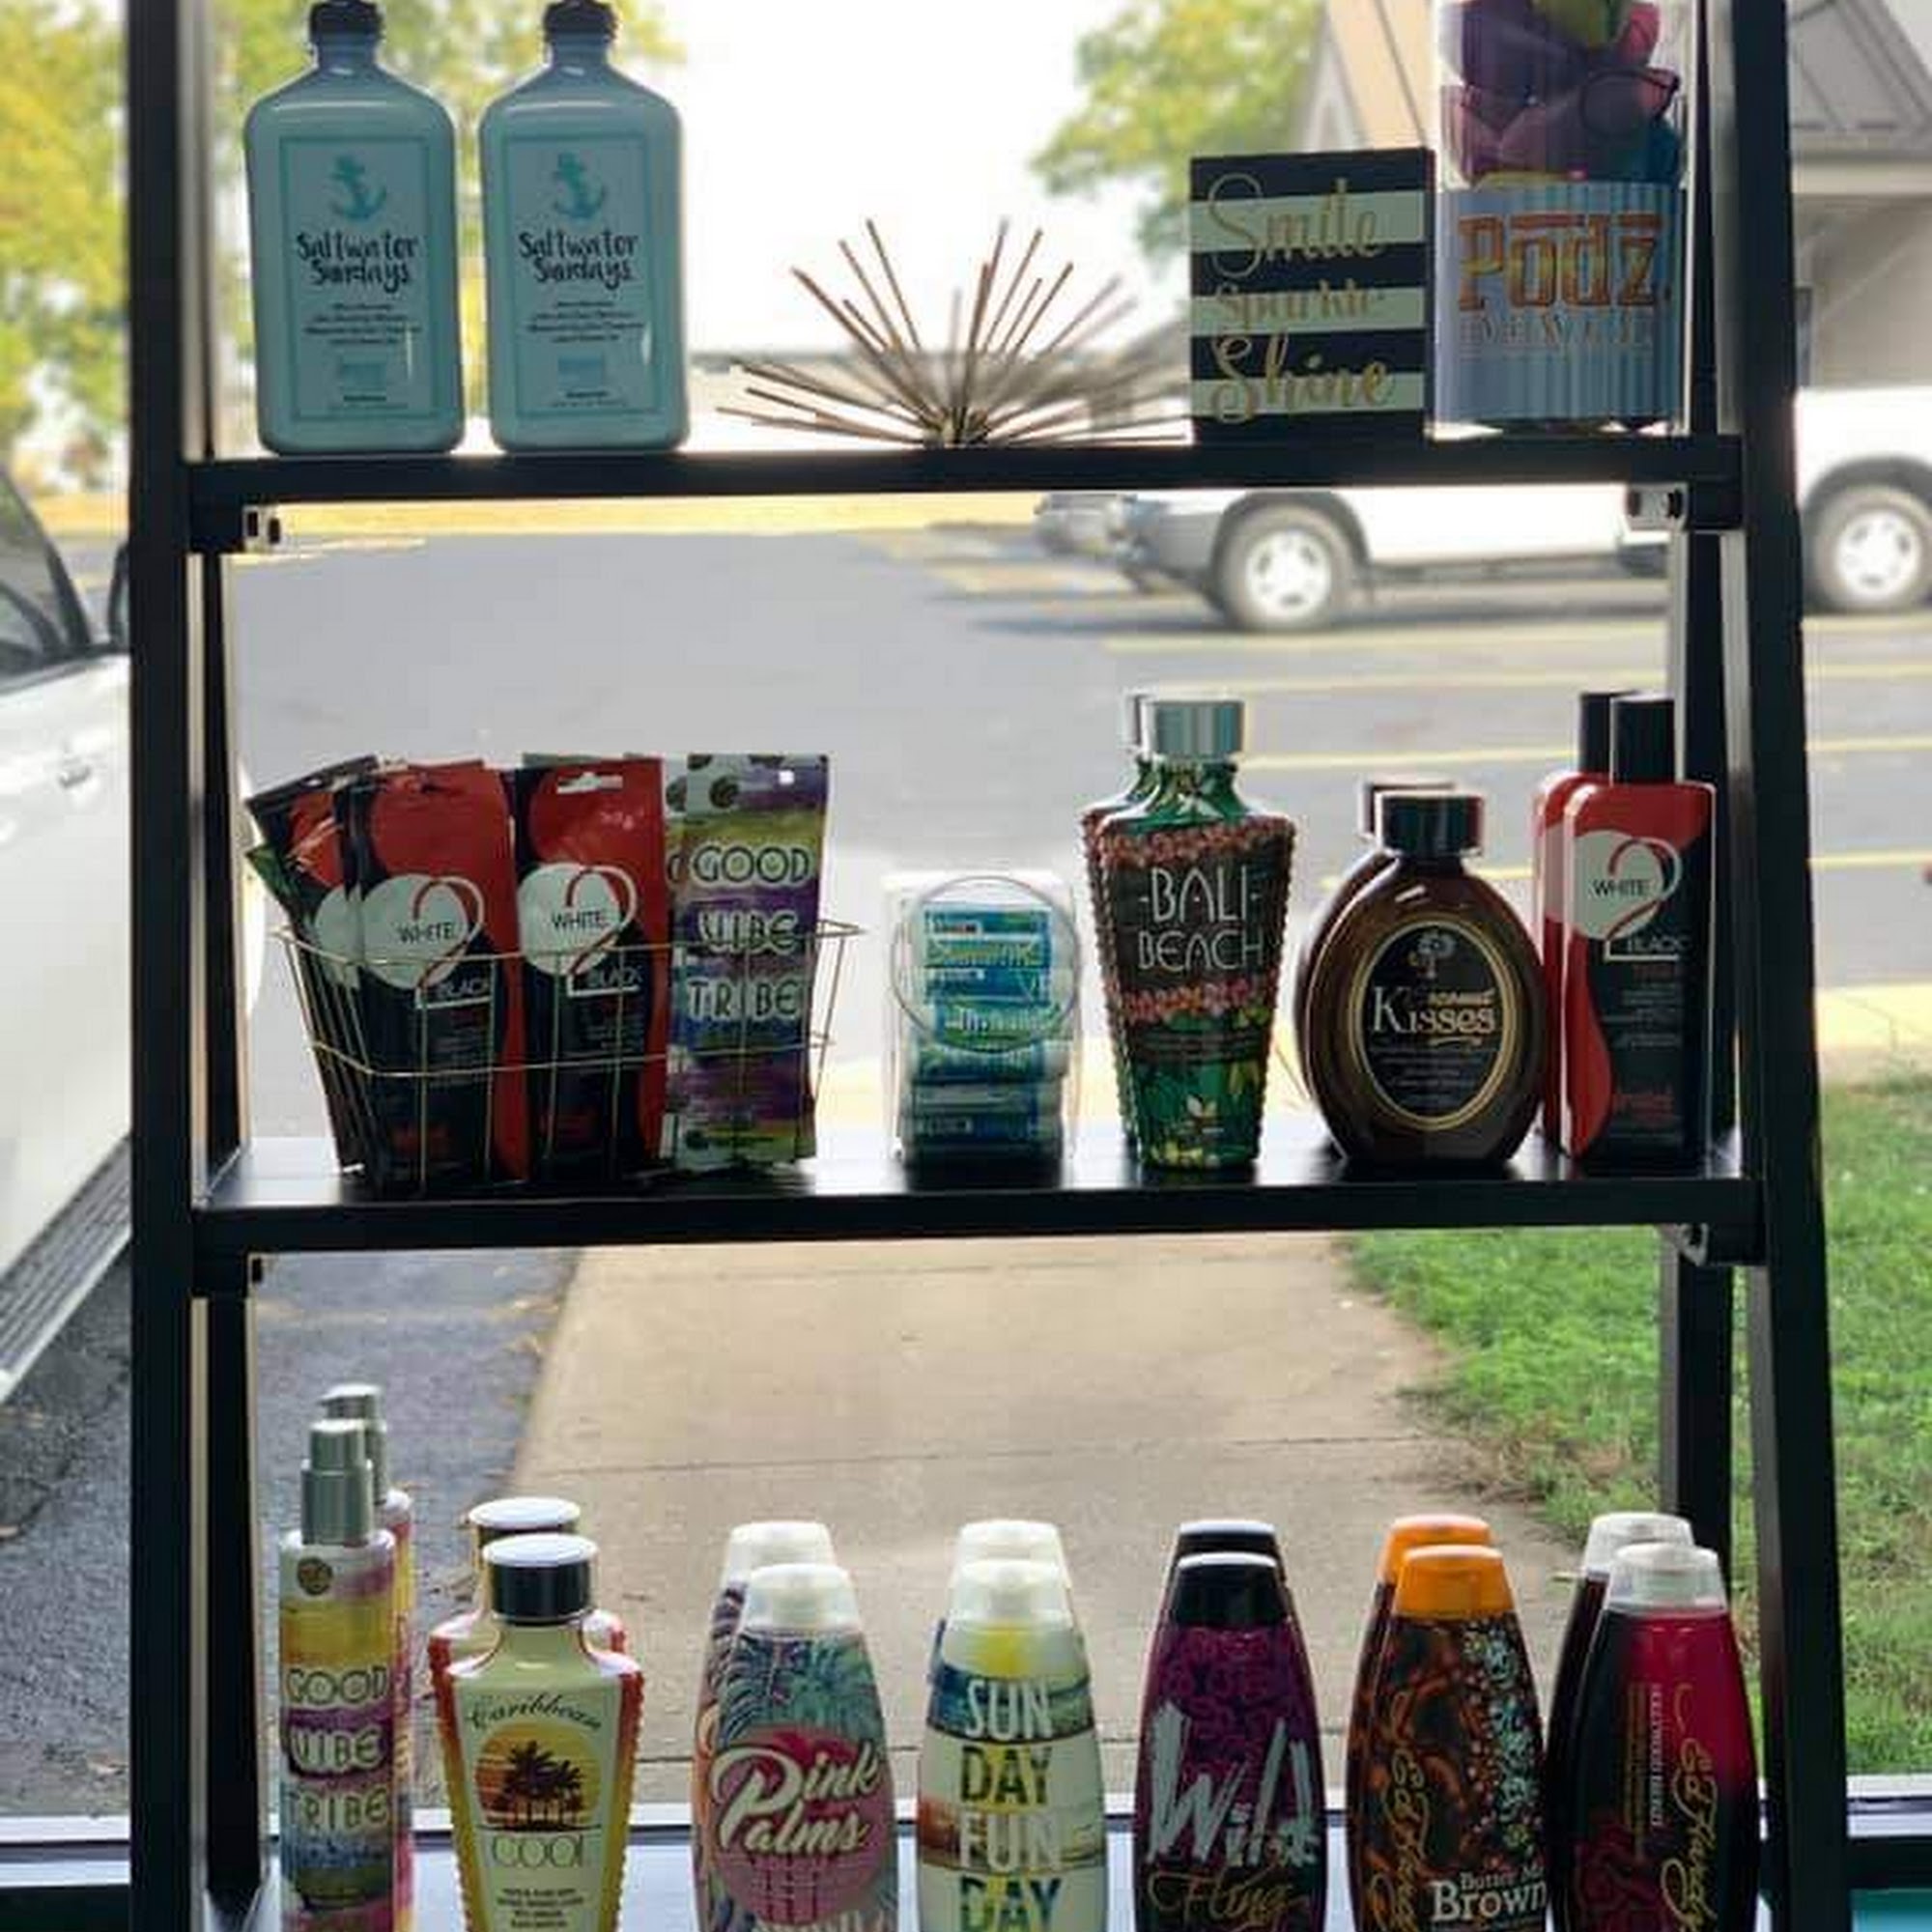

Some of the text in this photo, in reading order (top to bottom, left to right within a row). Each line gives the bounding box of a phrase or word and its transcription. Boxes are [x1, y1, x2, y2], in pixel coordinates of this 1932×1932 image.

[296, 231, 418, 262] Saltwater
[518, 228, 640, 259] Saltwater
[1208, 172, 1384, 278] Smile
[1210, 328, 1396, 425] Shine
[690, 842, 813, 885] GOOD
[1592, 878, 1651, 898] WHITE
[397, 921, 456, 944] WHITE
[550, 910, 607, 929] WHITE
[696, 909, 800, 953] VIBE
[1137, 928, 1264, 972] BEACH
[686, 975, 805, 1021] TRIBE
[1374, 985, 1496, 1035] Kisses
[286, 1667, 388, 1707] GOOD
[966, 1679, 1053, 1739] SUN
[465, 1692, 603, 1732] Caribbean
[292, 1729, 385, 1776] VIBE
[959, 1744, 1053, 1805] DAY
[711, 1741, 881, 1850] Pink
[958, 1809, 1062, 1871] FUN
[959, 1874, 1062, 1932] DAY
[1432, 1878, 1547, 1921] Brown
